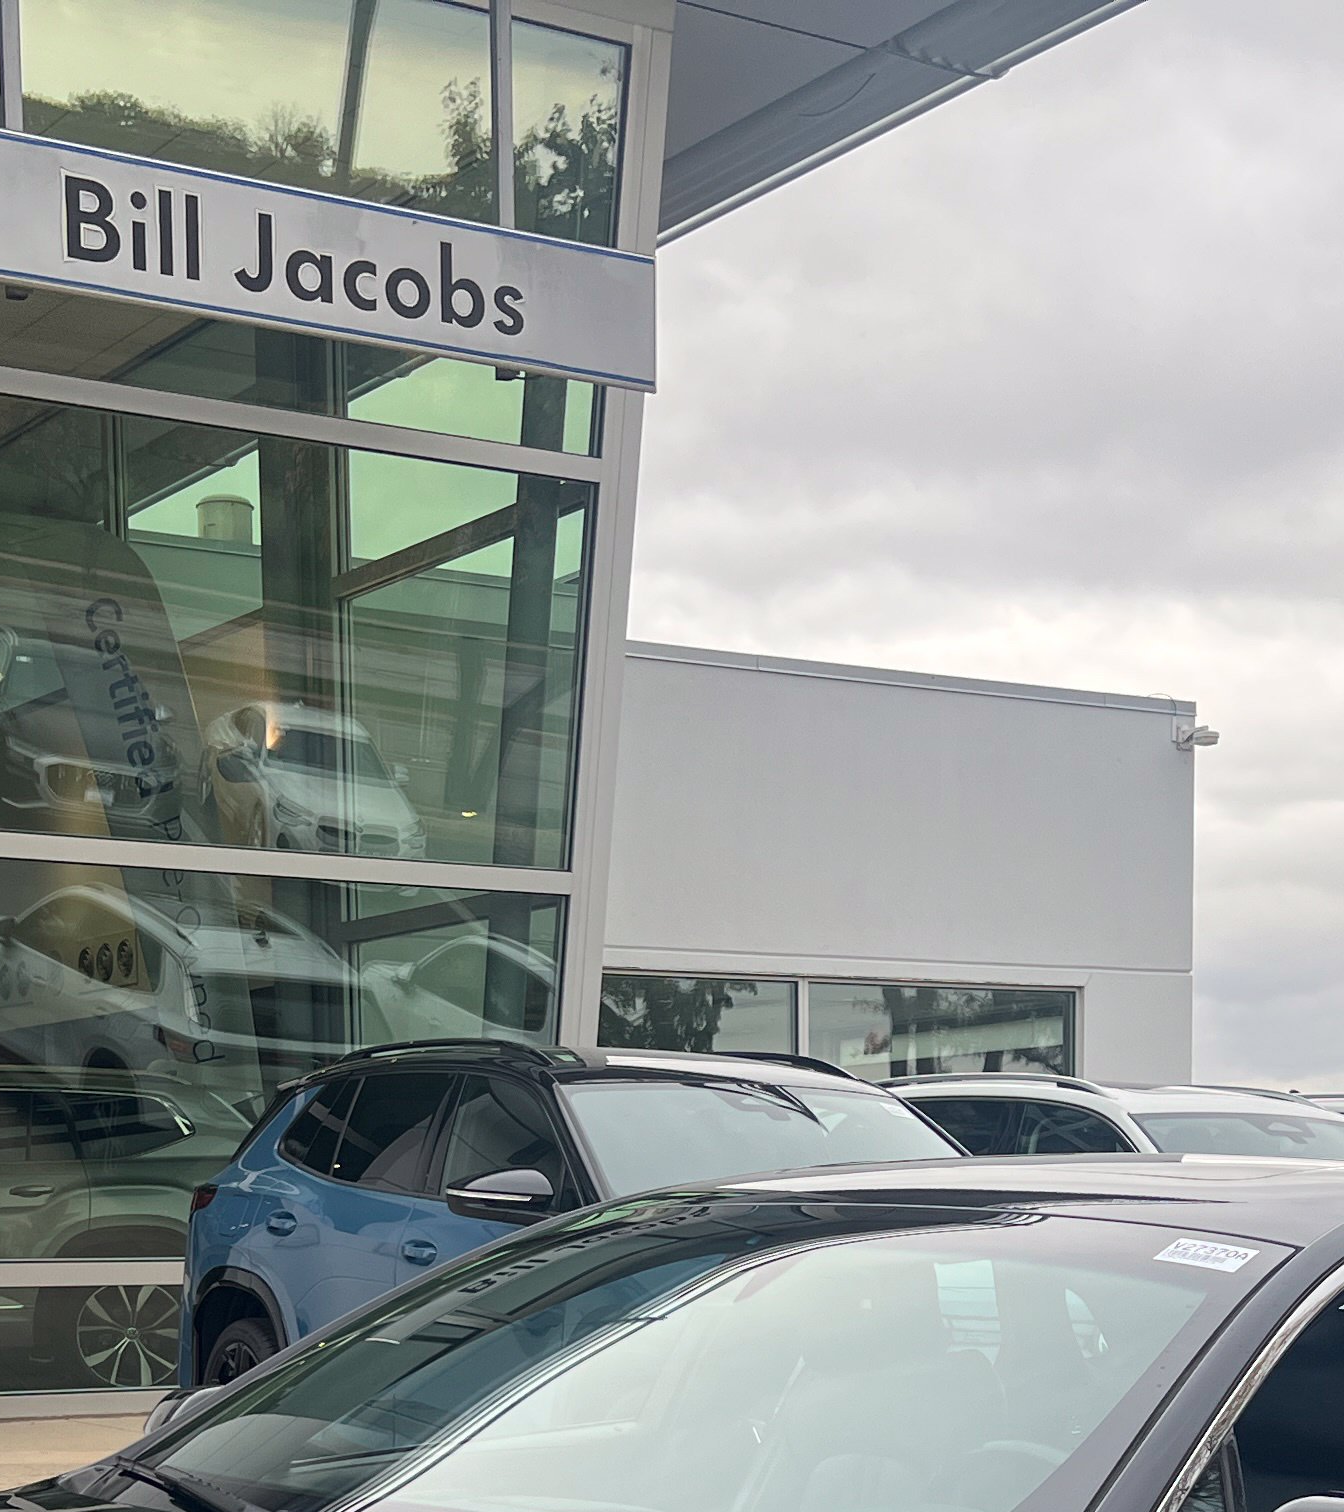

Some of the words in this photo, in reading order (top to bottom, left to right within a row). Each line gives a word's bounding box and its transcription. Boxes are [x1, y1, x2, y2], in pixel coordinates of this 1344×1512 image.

[64, 174, 201, 282] Bill
[233, 212, 525, 337] Jacobs
[86, 597, 174, 799] Certified
[1173, 1241, 1249, 1261] V27370A
